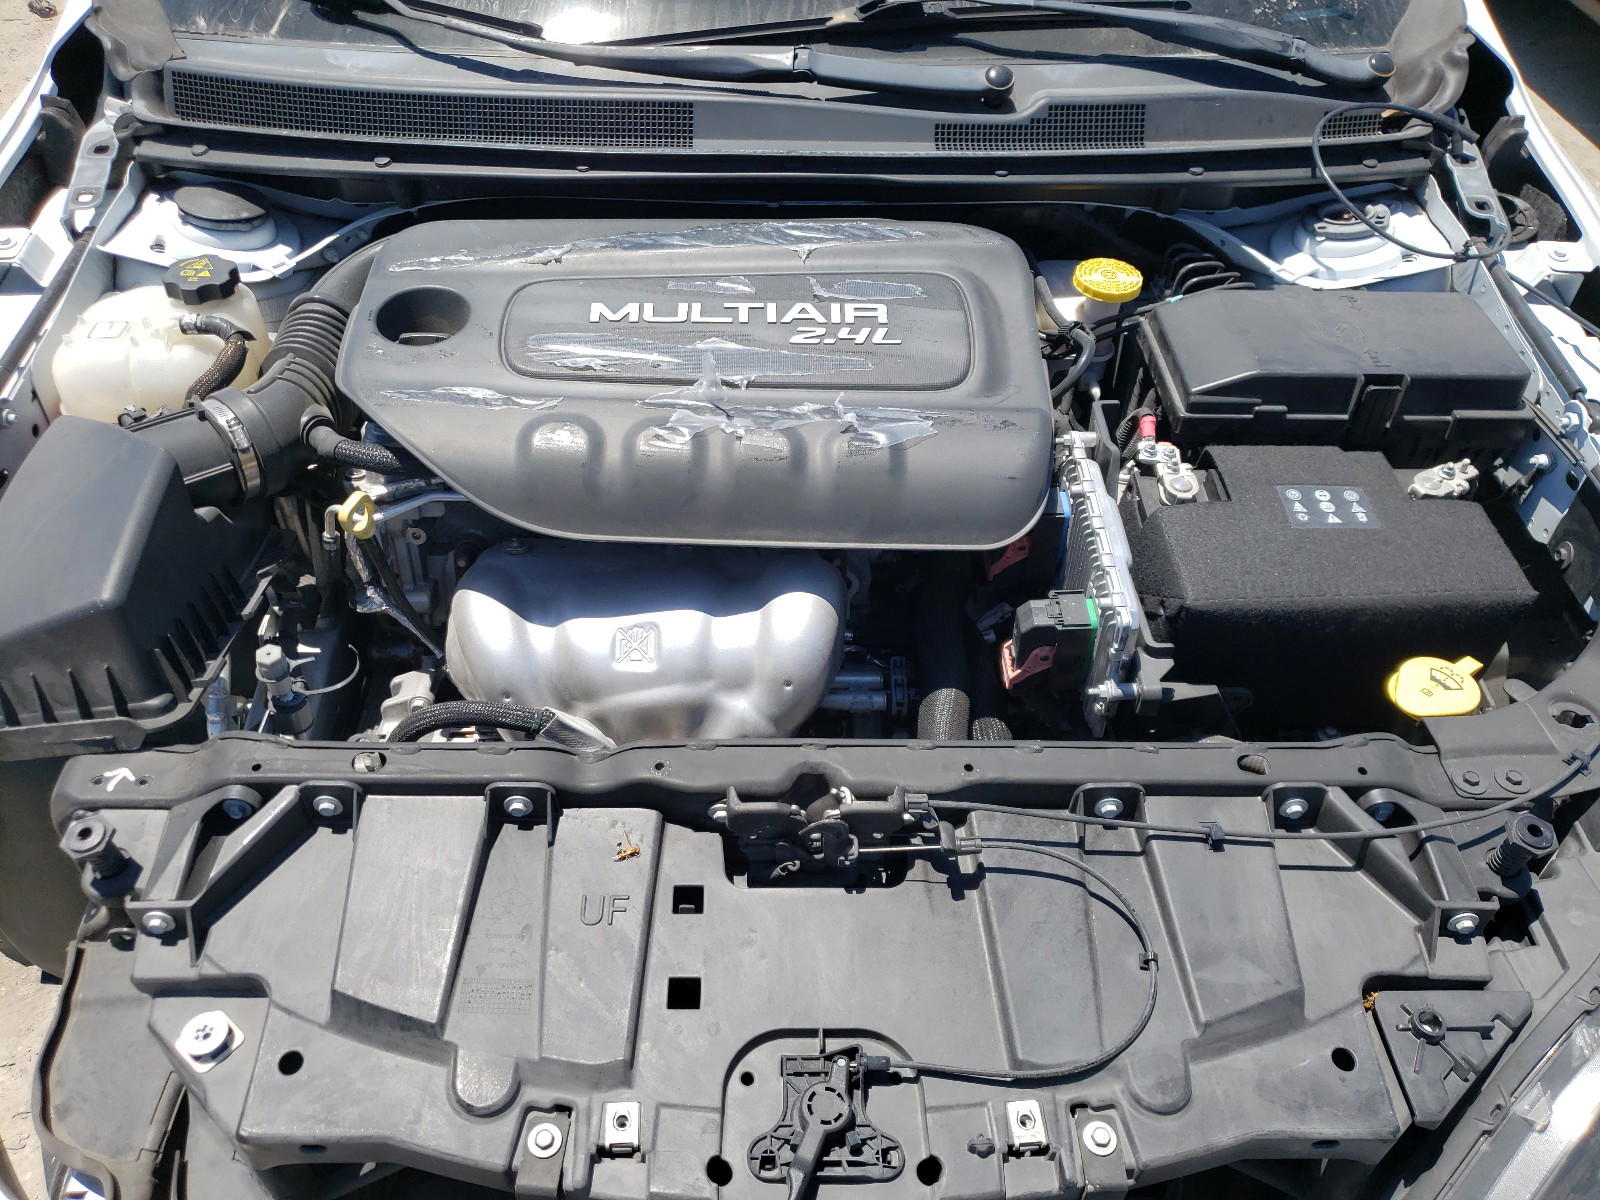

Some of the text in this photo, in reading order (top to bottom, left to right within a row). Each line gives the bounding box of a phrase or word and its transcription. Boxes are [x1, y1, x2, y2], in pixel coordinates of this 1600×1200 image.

[589, 302, 889, 324] MULTIAIR
[789, 327, 903, 345] 2.4L
[579, 894, 631, 926] UF
